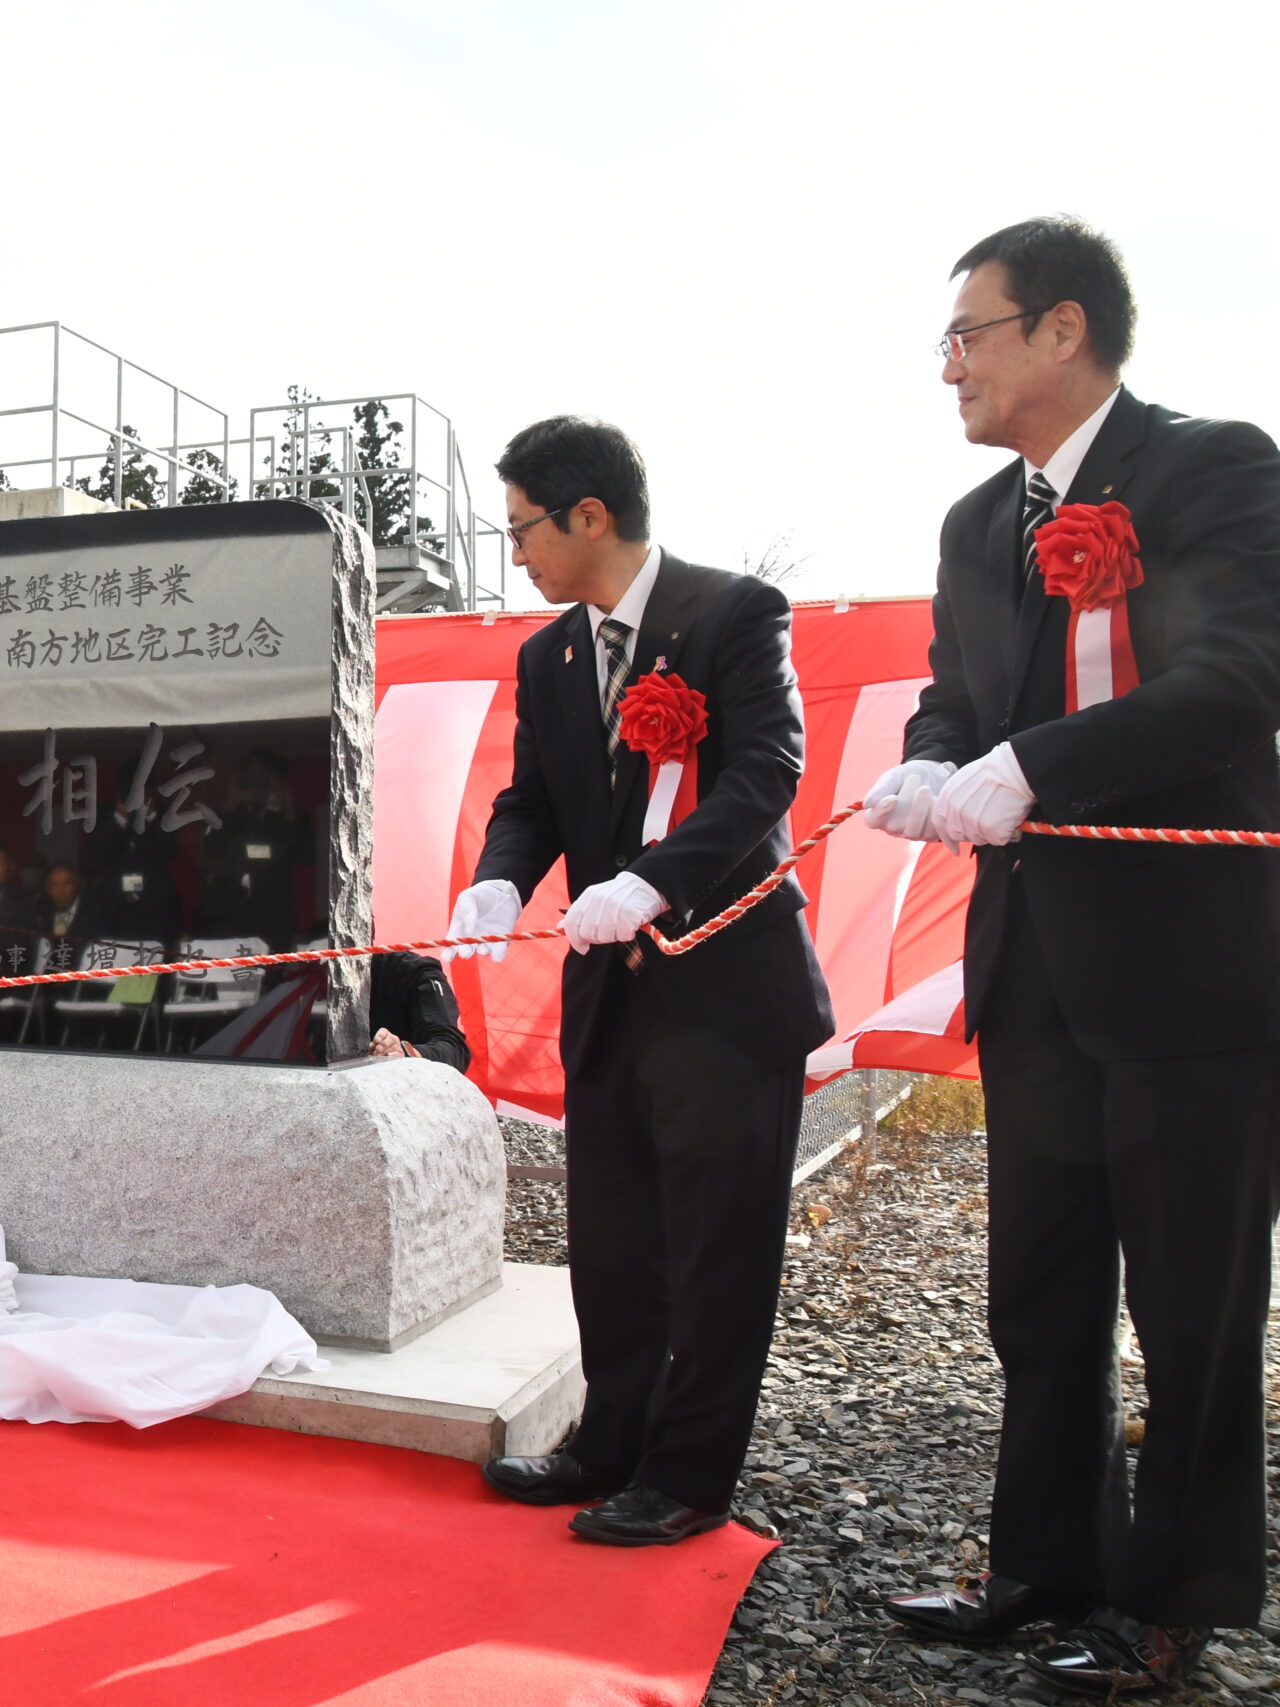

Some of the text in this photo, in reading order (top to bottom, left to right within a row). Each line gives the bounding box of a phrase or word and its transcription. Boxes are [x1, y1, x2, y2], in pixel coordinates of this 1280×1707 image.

[6, 617, 284, 669] 南方地区完工記念
